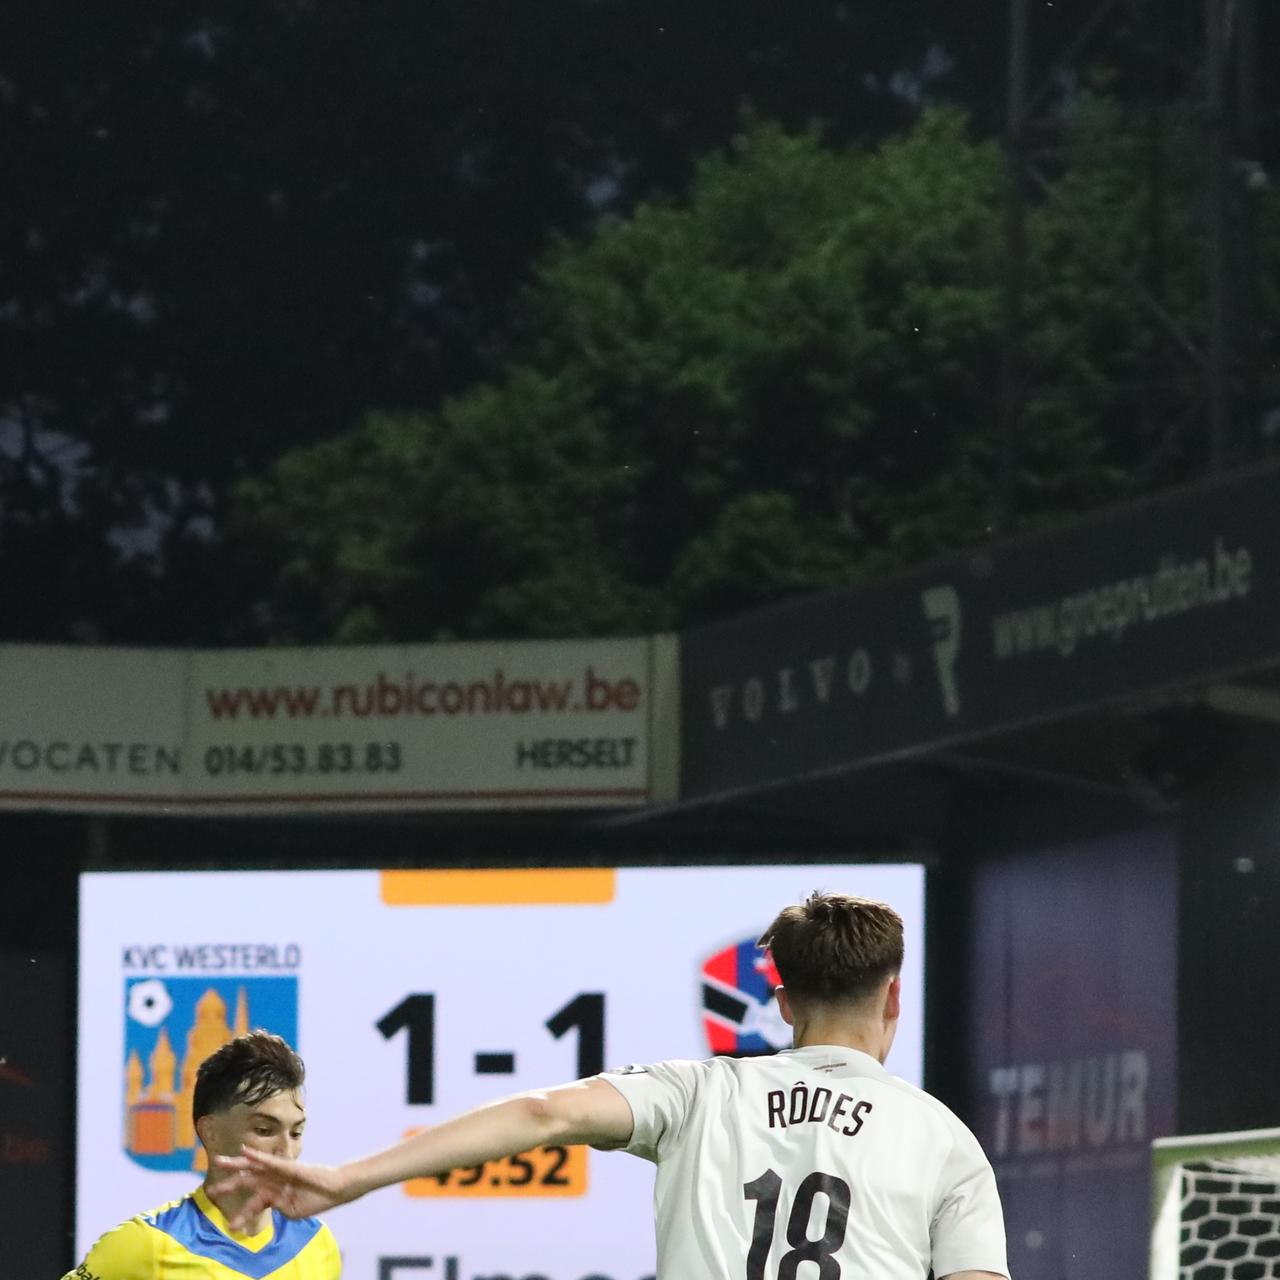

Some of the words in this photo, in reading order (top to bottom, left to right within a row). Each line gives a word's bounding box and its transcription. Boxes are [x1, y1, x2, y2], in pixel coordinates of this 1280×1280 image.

[207, 667, 639, 720] www.rubiconlaw.be
[710, 648, 871, 728] VOLVO
[206, 742, 400, 776] 014/53.83.83
[516, 736, 636, 772] HERSELT
[123, 947, 167, 970] KVC
[174, 943, 301, 970] WESTERLO
[990, 1051, 1147, 1156] TEMUR
